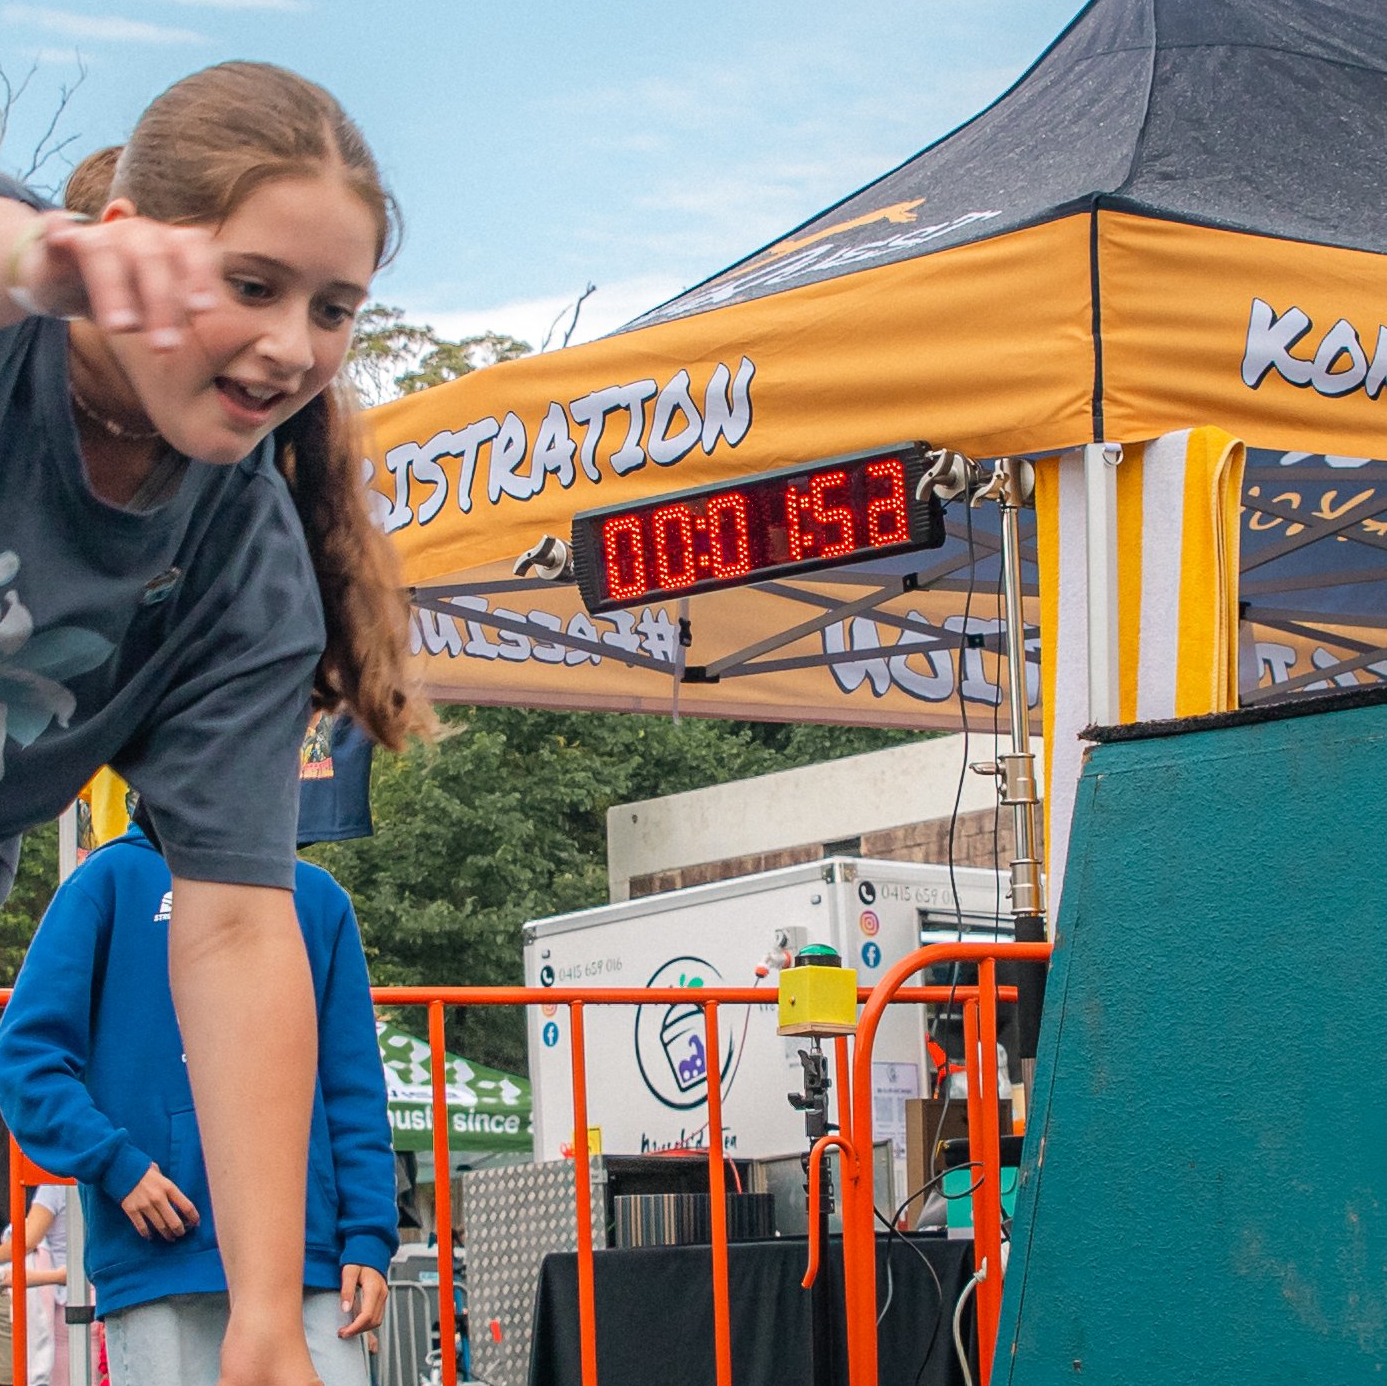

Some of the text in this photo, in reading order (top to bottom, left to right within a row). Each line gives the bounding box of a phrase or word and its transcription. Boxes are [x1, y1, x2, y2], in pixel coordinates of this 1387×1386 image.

[559, 964, 582, 982] 0415
[585, 960, 604, 976] 659
[453, 1108, 520, 1134] since
